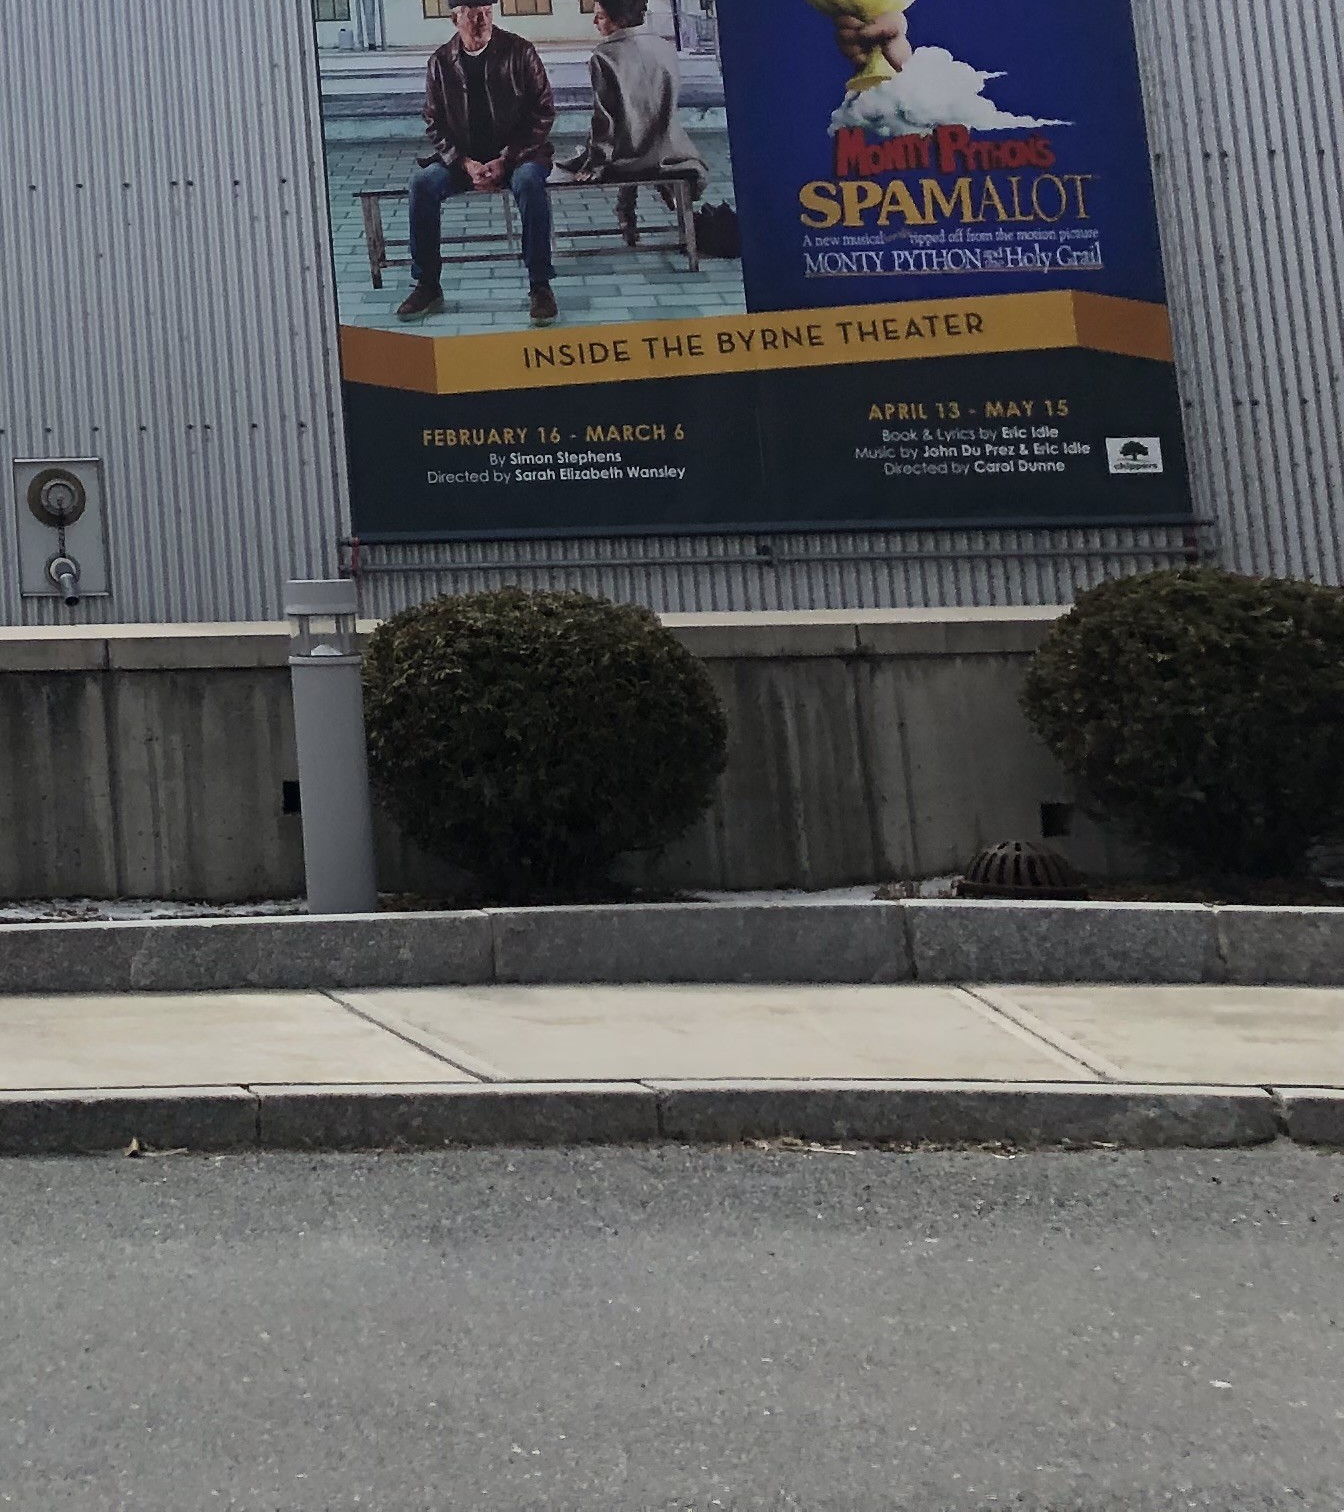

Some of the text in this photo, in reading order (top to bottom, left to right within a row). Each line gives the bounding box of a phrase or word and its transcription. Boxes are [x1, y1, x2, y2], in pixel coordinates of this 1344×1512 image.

[835, 124, 932, 177] MONTY
[799, 174, 1092, 229] SPAMALOT
[803, 234, 812, 247] A
[815, 236, 840, 246] new
[842, 230, 885, 246] musical
[909, 229, 946, 247] ripped
[948, 228, 963, 242] off
[966, 227, 992, 242] from
[995, 227, 1013, 241] the
[1016, 228, 1056, 240] motion
[1058, 228, 1099, 243] picture
[803, 251, 884, 274] MONTY
[891, 247, 982, 272] PYTHON
[1005, 242, 1052, 273] Holy
[1056, 241, 1102, 267] Grail
[524, 312, 984, 369] INSIDE THE BYRNE THEATER
[868, 402, 928, 420] APRIL
[935, 400, 961, 419] 13
[985, 400, 1033, 418] MAY
[1044, 399, 1069, 417] 15
[423, 427, 528, 446] FEBRUARY
[538, 427, 561, 444] 16
[585, 424, 666, 442] MARCH
[674, 423, 685, 440] 6
[882, 428, 918, 442] Book
[937, 428, 976, 442] Lyrics
[979, 427, 997, 441] by
[1002, 426, 1028, 439] Eric
[1032, 426, 1059, 438] Idle
[489, 451, 622, 466] By Simon Stephens
[855, 445, 896, 459] Music
[900, 445, 918, 460] by
[923, 444, 958, 458] John
[961, 444, 981, 456] Du
[1019, 443, 1029, 456] &
[1033, 442, 1059, 456] Eric
[1063, 441, 1091, 455] Idle
[427, 464, 686, 484] Directed by Sarah Elizabeth Wansley
[883, 458, 1066, 476] Directed by Carol Dunne
